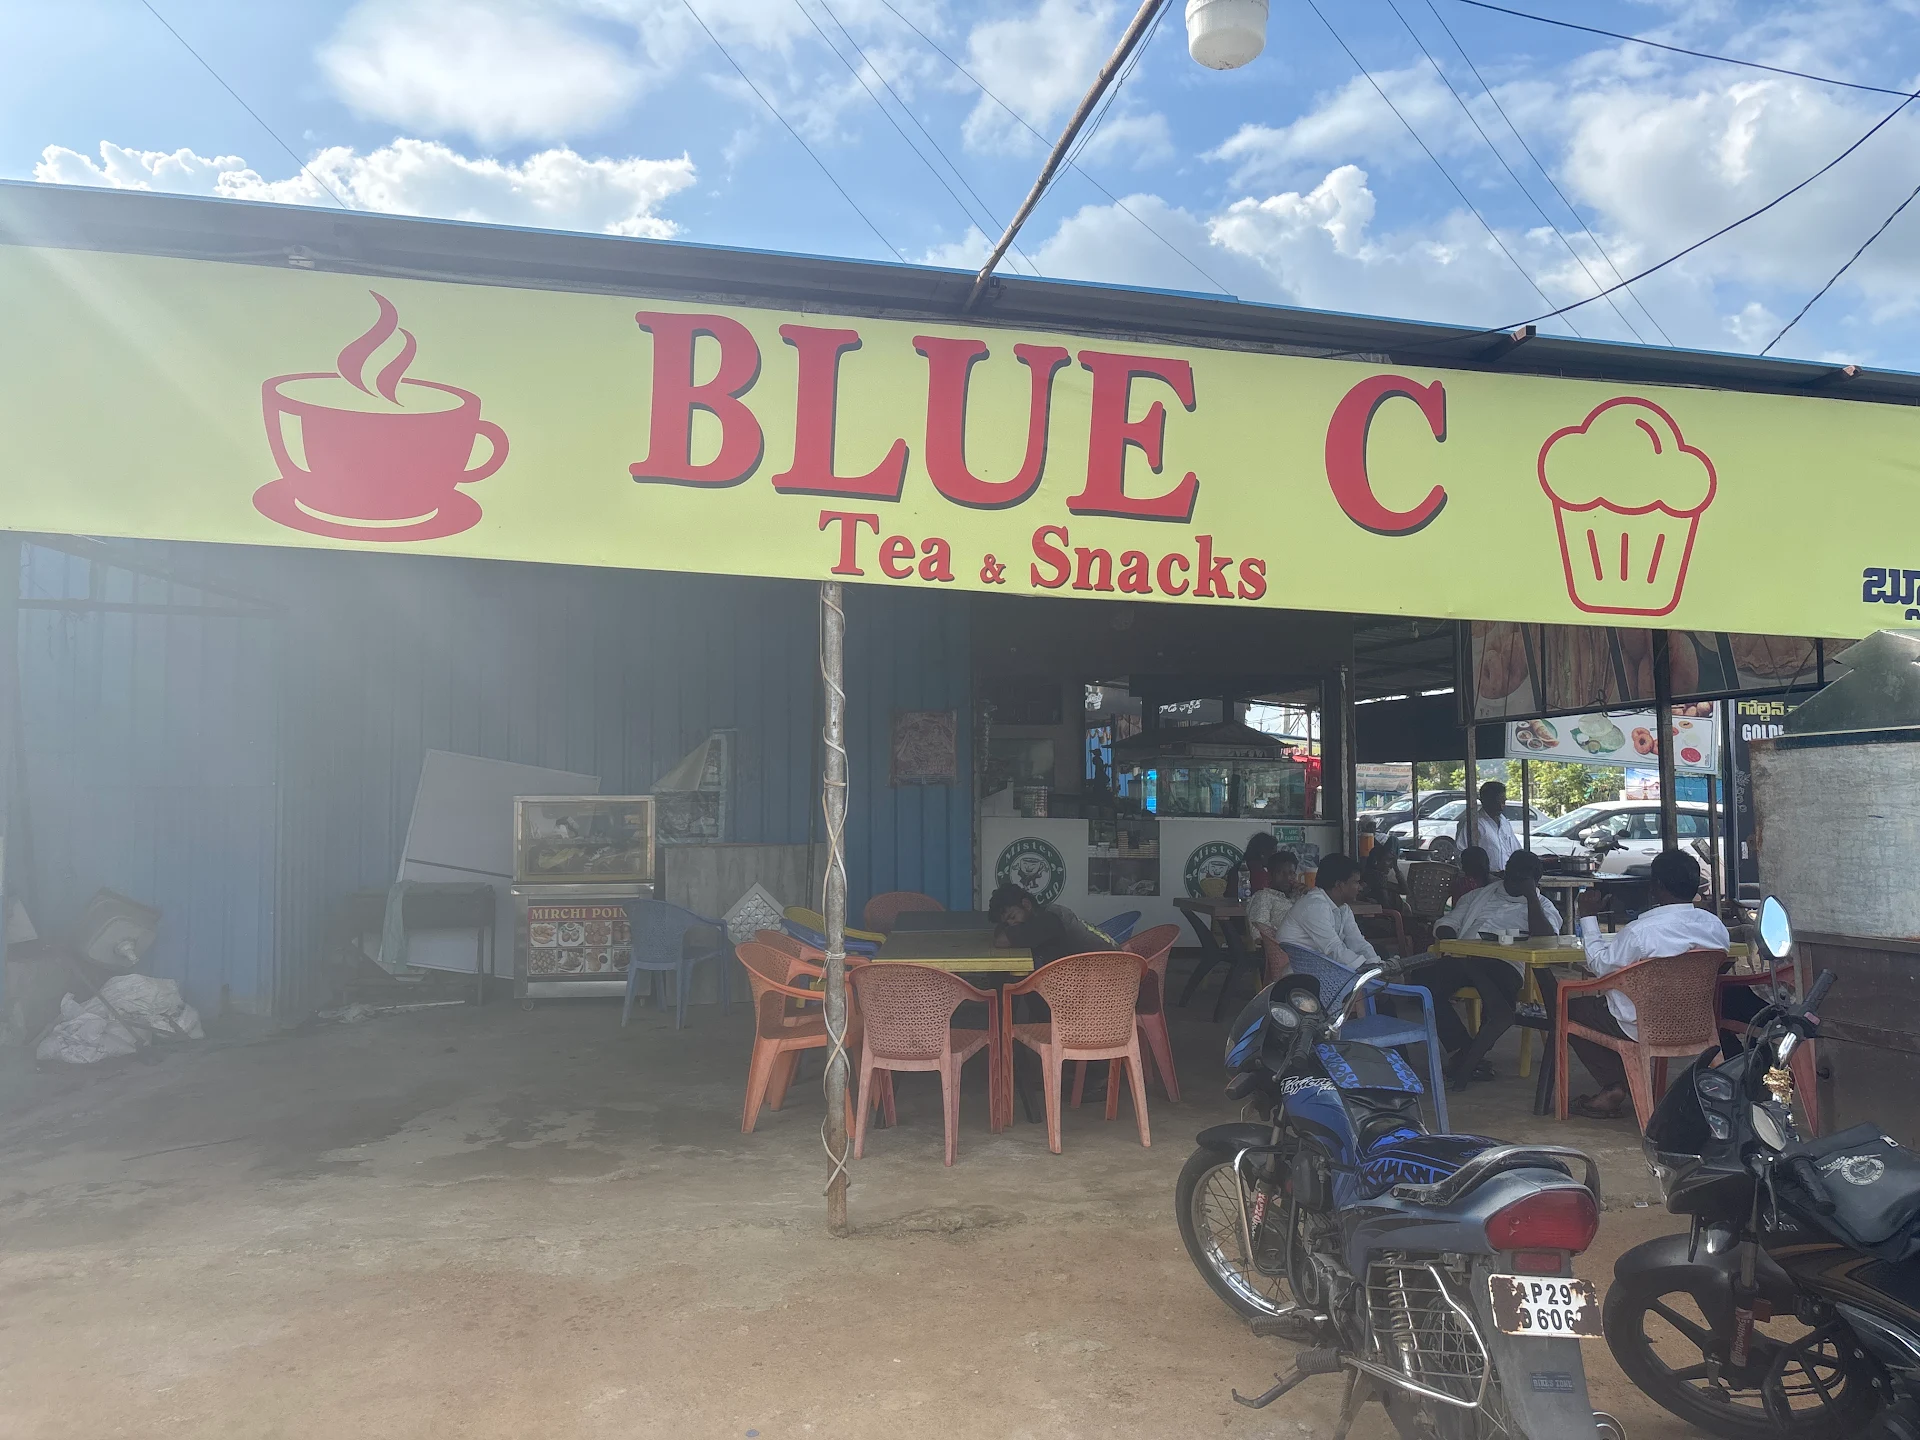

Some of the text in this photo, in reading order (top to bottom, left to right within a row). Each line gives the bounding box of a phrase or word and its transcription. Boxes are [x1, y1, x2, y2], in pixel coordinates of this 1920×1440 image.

[629, 312, 1447, 536] BLUE C
[818, 510, 1267, 601] Tea & Snacks
[1004, 841, 1053, 864] Mister
[1035, 881, 1060, 905] Cup
[531, 907, 628, 920] MIRCHI POIN
